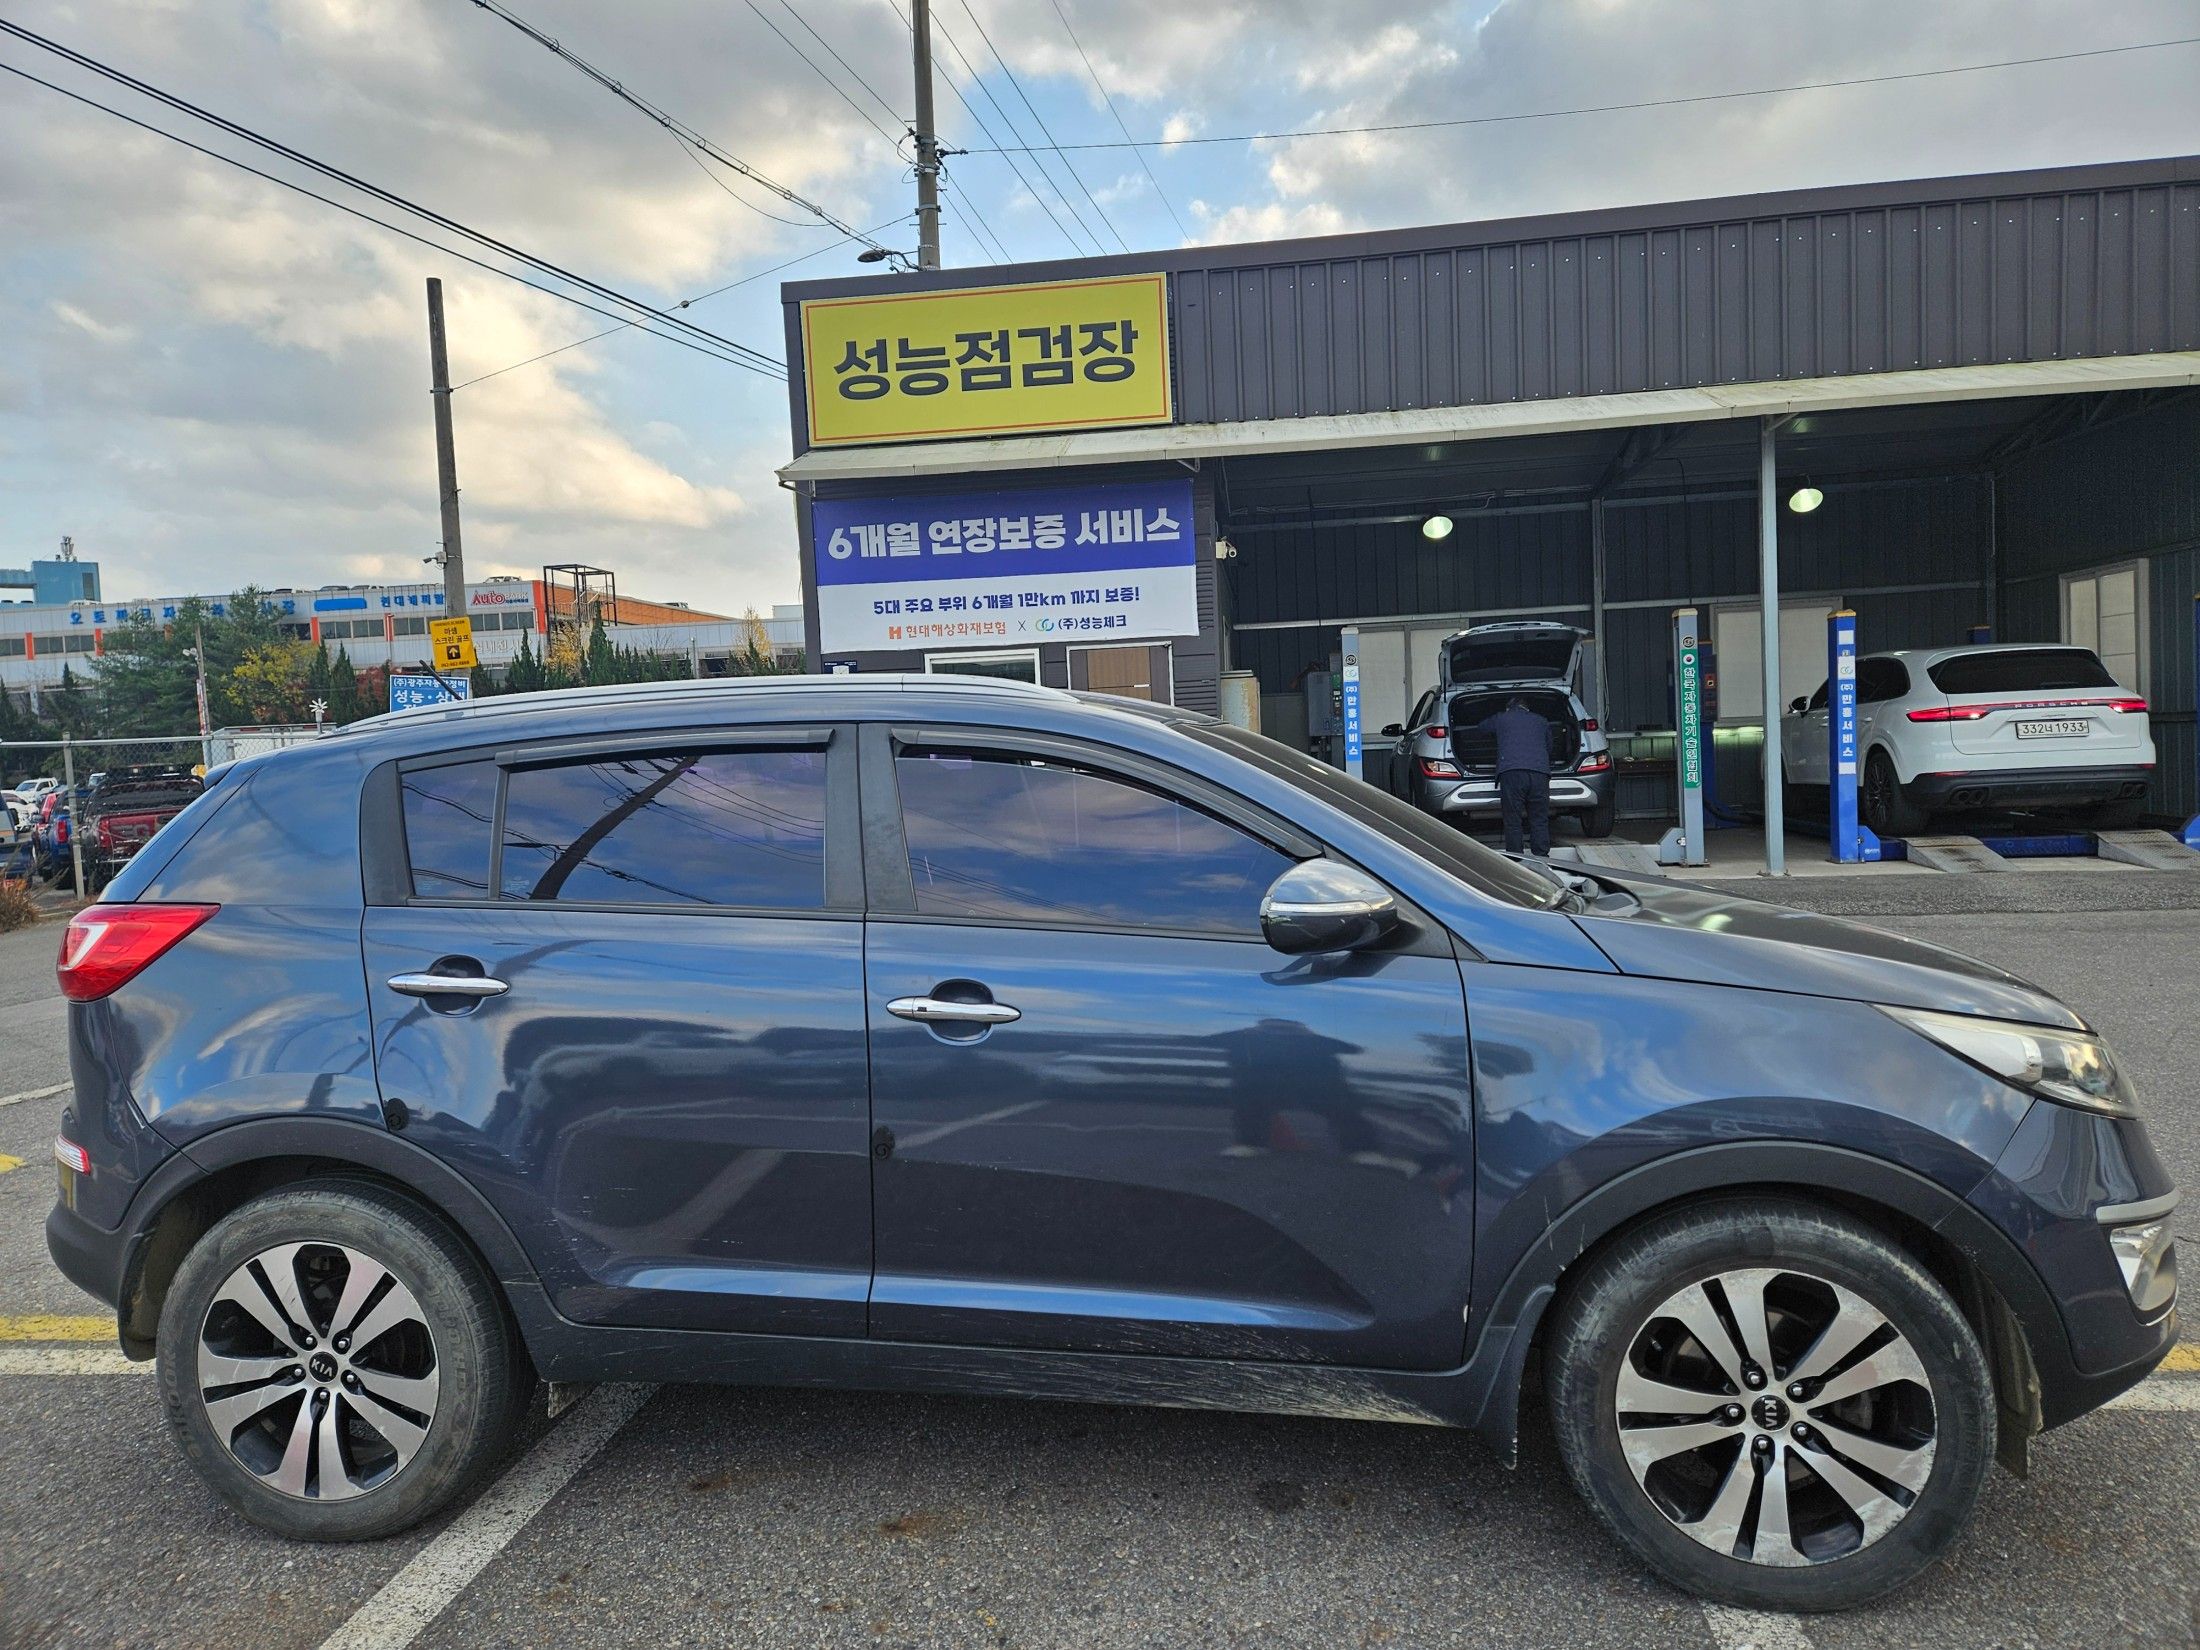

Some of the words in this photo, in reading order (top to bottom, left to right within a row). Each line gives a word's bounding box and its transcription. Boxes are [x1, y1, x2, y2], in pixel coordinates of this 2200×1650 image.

[833, 319, 1139, 401] 성능점검장
[828, 522, 921, 560] 6개월
[928, 514, 1067, 555] 연장보증
[1074, 507, 1181, 547] 서비스
[873, 599, 901, 615] 5대
[904, 598, 934, 613] 주요
[938, 596, 967, 612] 부위
[971, 593, 1014, 610] 6개월
[1017, 592, 1066, 608] 1만km
[1070, 589, 1100, 605] 까지
[1105, 586, 1141, 604] 보증!
[905, 621, 1006, 639] 현대해상화재보험
[1058, 614, 1128, 631] (주)성능체크
[2055, 722, 2085, 733] 1933
[311, 1358, 334, 1377] KIA
[1764, 1399, 1778, 1429] KIA
